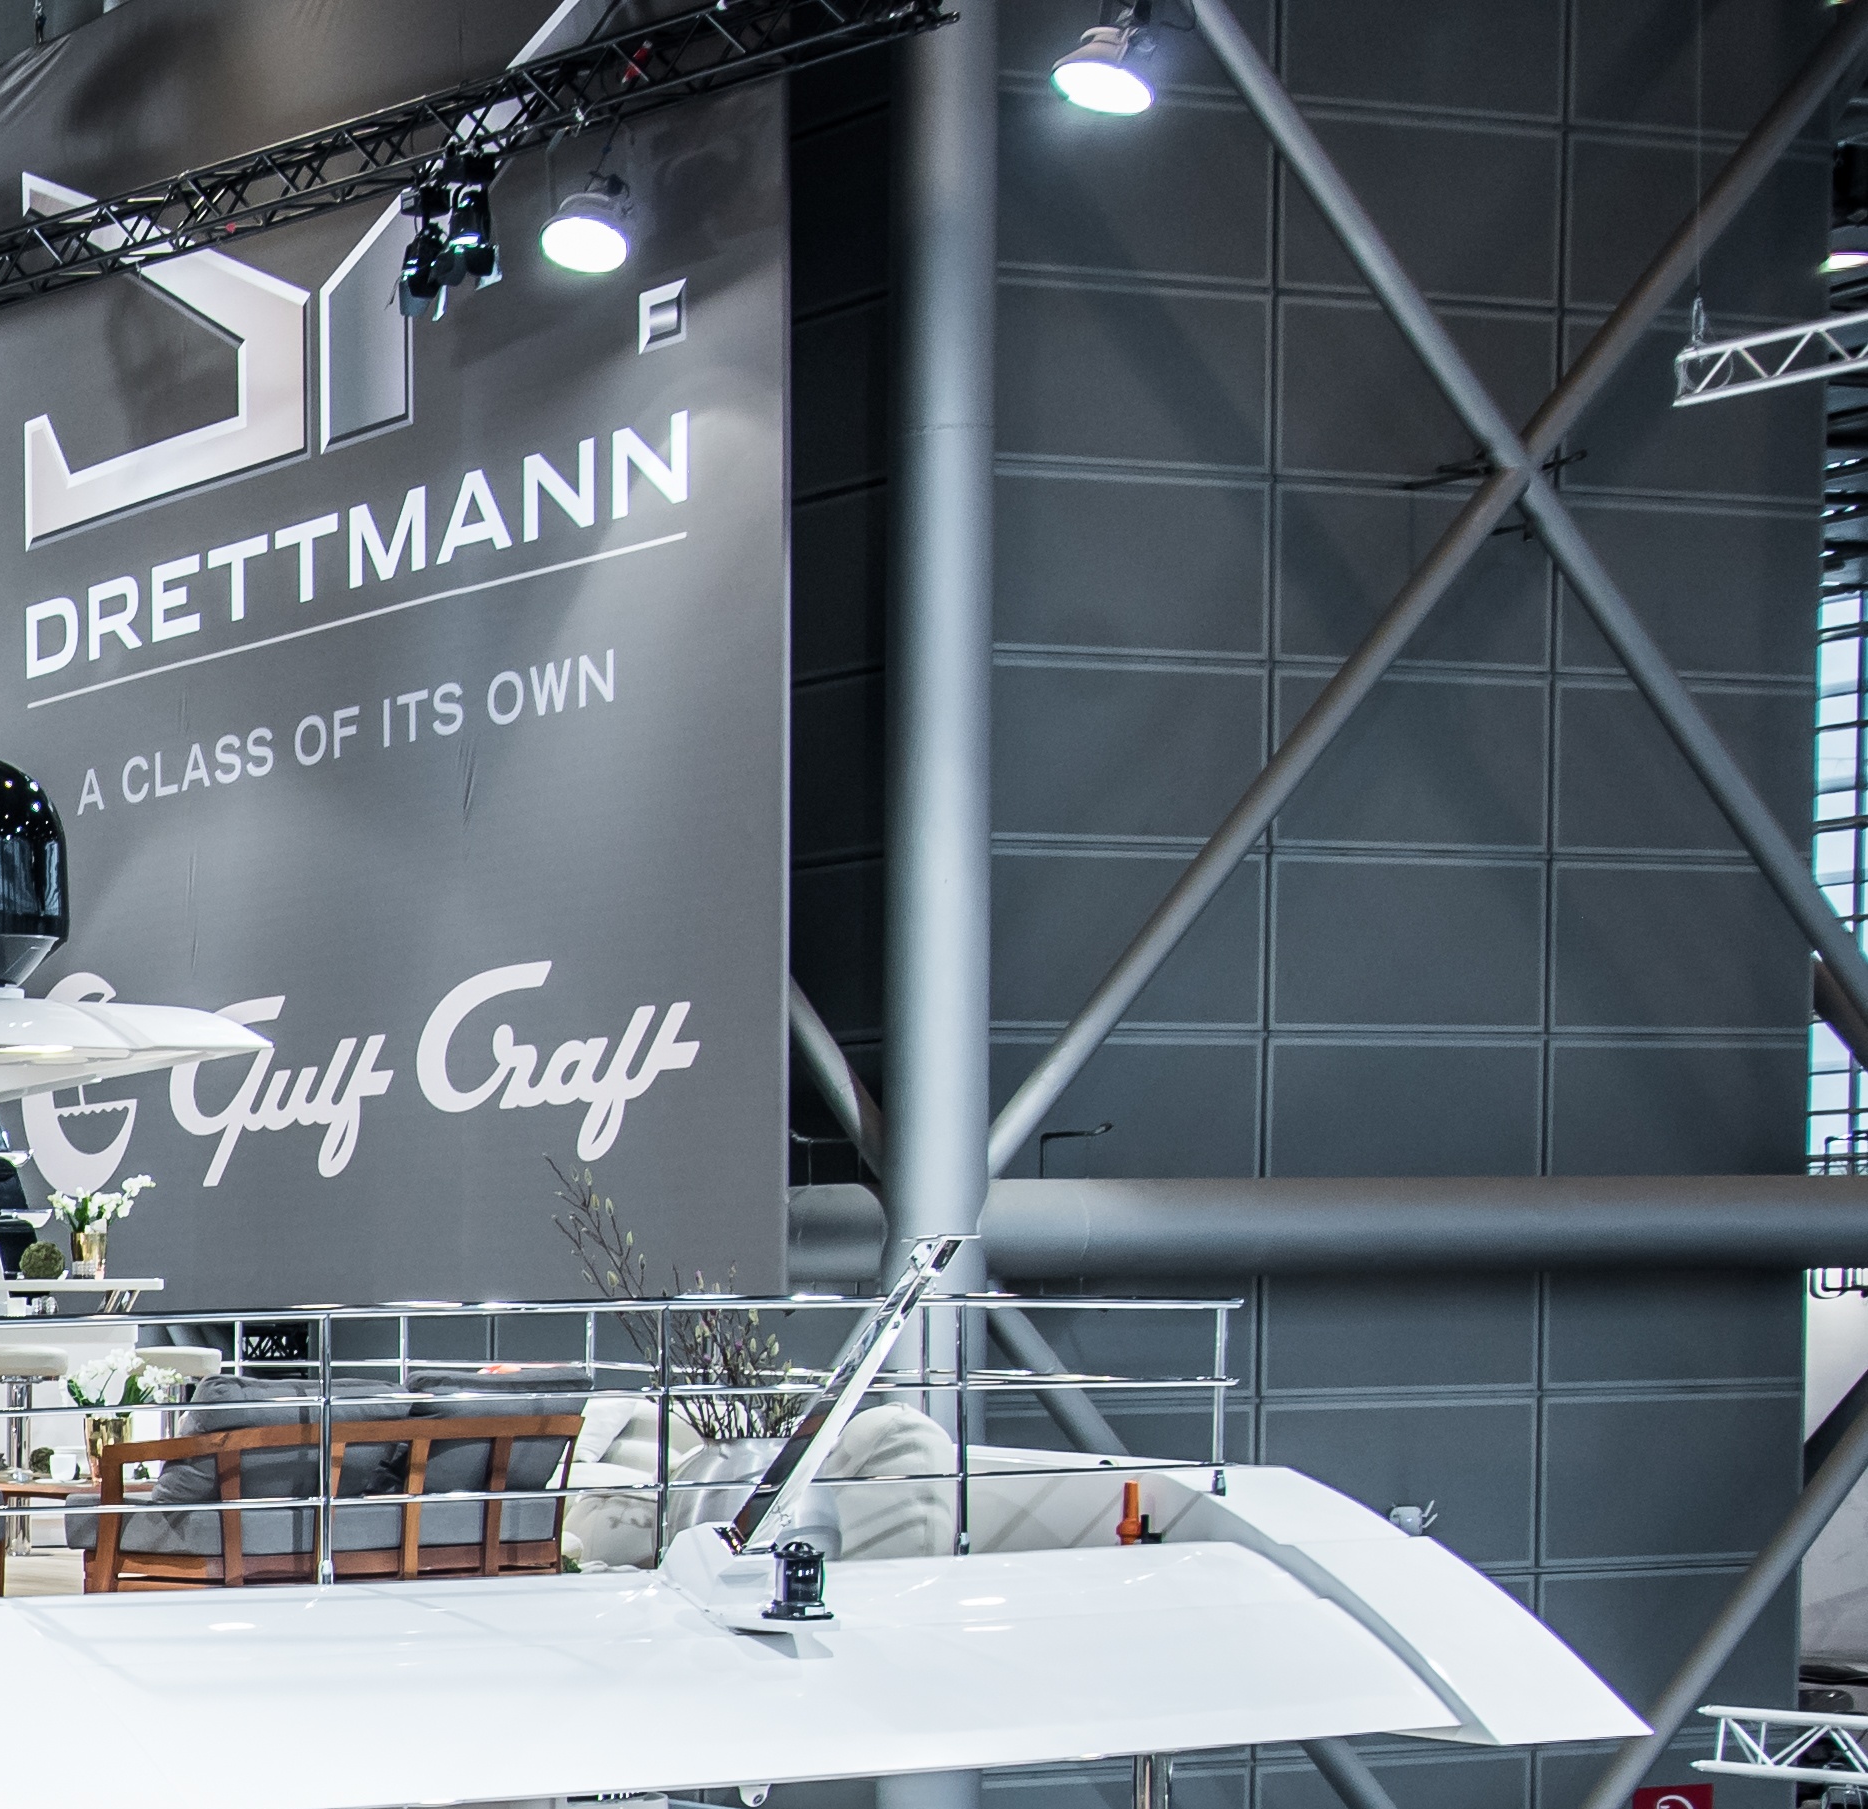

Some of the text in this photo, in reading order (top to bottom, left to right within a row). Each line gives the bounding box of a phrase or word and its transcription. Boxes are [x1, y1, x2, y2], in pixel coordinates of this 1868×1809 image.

[25, 409, 689, 681] DRETTMANN
[77, 650, 616, 816] A CLASS OF ITS OWN
[169, 960, 700, 1188] Gulf Craft
